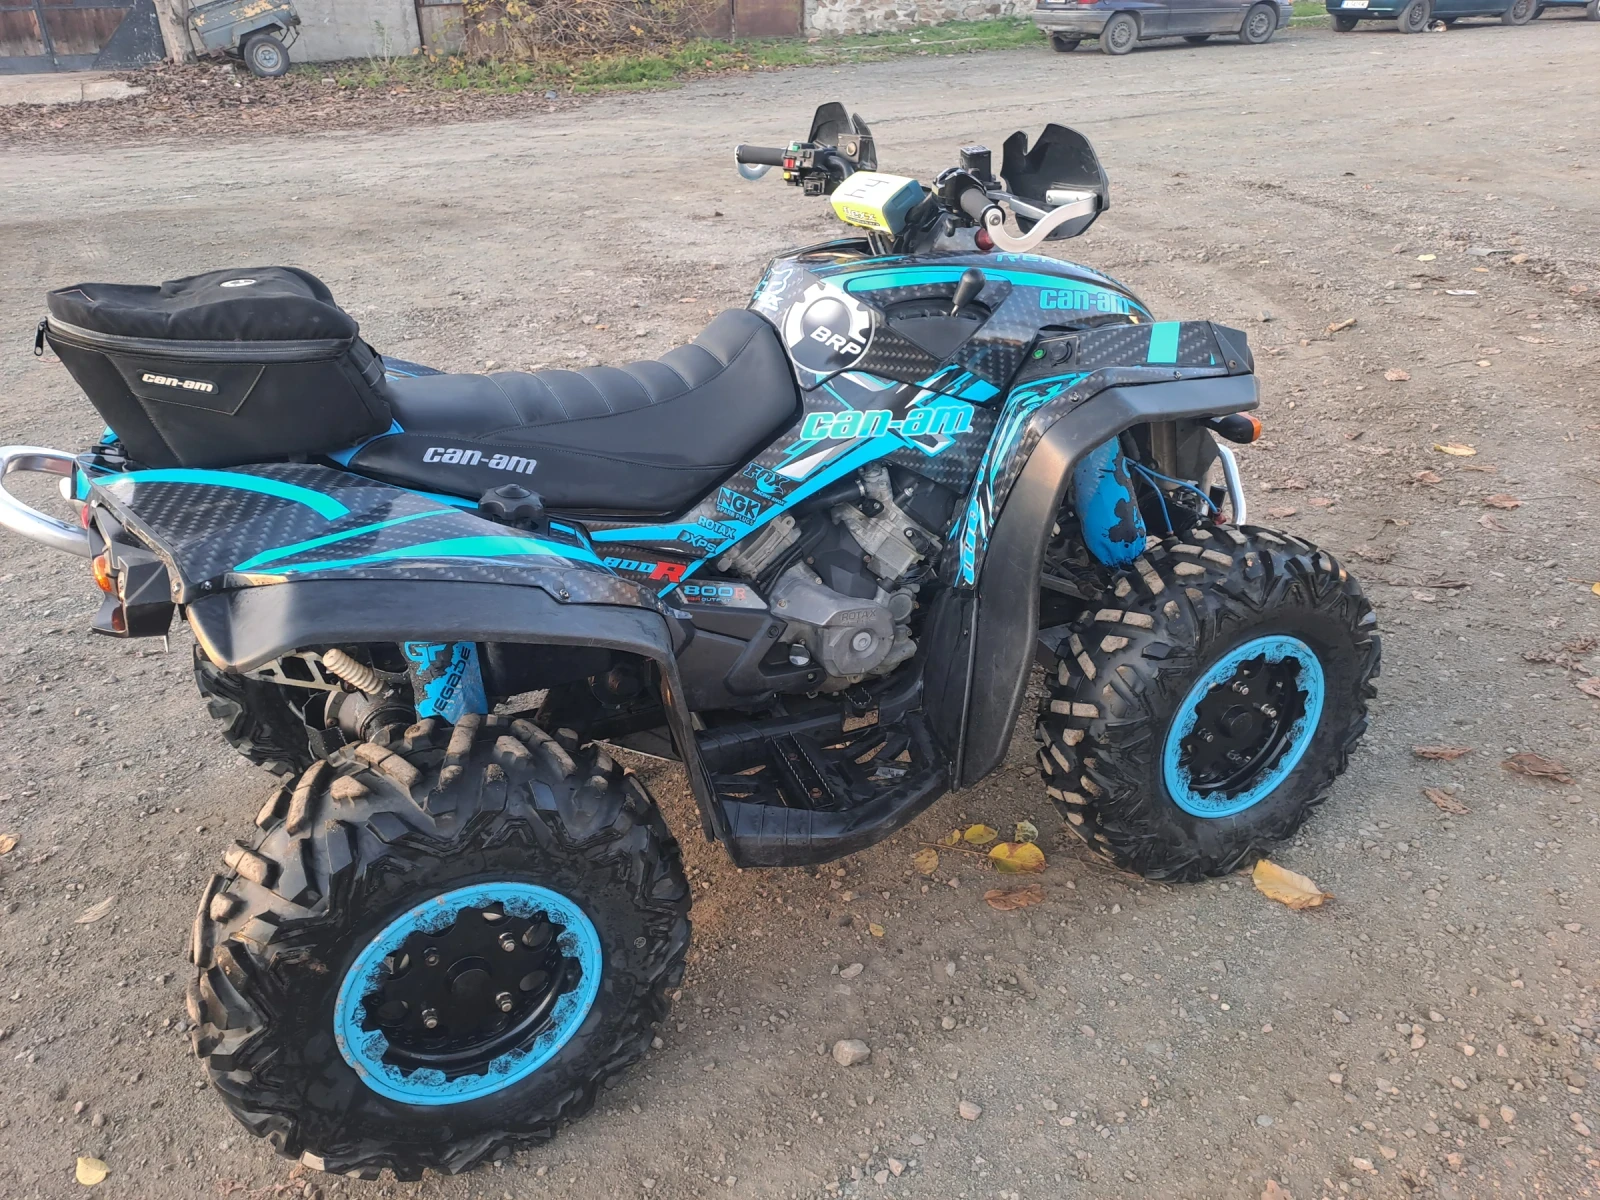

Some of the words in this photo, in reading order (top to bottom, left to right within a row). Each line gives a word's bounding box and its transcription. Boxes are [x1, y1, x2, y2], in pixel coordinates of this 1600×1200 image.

[1039, 289, 1129, 313] can-am
[810, 325, 862, 355] BRP
[142, 373, 213, 392] can-am
[800, 404, 975, 440] can-am
[422, 447, 537, 475] can-am
[743, 462, 790, 490] FOX
[718, 487, 760, 519] NGK
[697, 515, 736, 539] ROTAX
[735, 512, 755, 526] PLUGS
[687, 532, 717, 554] XPS
[603, 556, 687, 583] 800R
[684, 585, 746, 599] 800R
[841, 609, 876, 621] ROTAX
